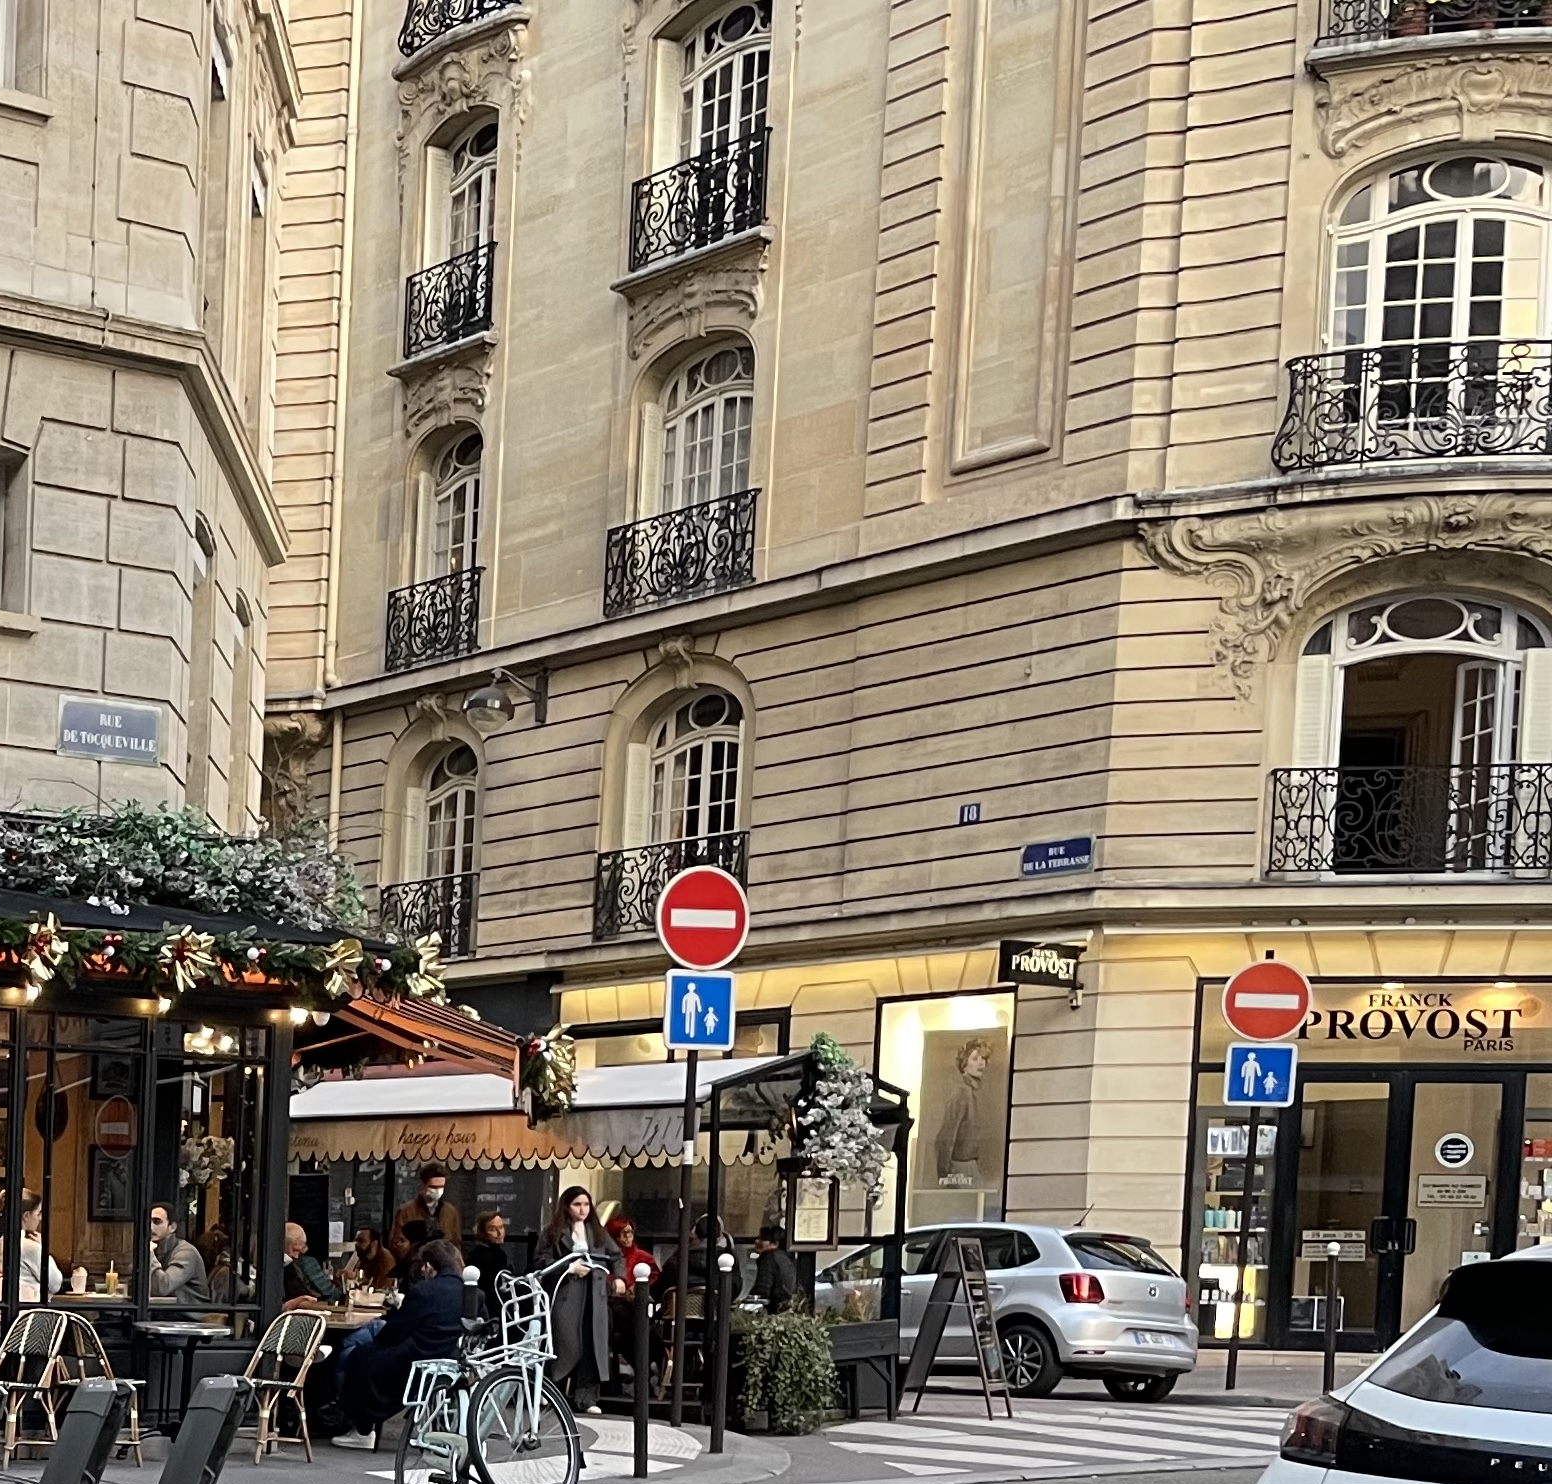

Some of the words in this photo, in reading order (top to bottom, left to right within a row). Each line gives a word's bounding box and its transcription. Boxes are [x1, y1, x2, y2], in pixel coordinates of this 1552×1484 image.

[99, 713, 123, 728] RUE
[63, 729, 79, 743] DE
[80, 731, 156, 752] TOCQUEVILLE
[963, 805, 978, 823] 18
[1048, 846, 1066, 857] RUE
[1035, 859, 1047, 871] LA
[1048, 854, 1090, 870] TERRASSE
[1011, 955, 1077, 975] PROVOST
[1369, 993, 1454, 1007] FRANCK
[1295, 1009, 1523, 1040] PROVOST
[1463, 1040, 1515, 1052] PARIS
[397, 1123, 441, 1150] happy
[444, 1122, 477, 1146] hour
